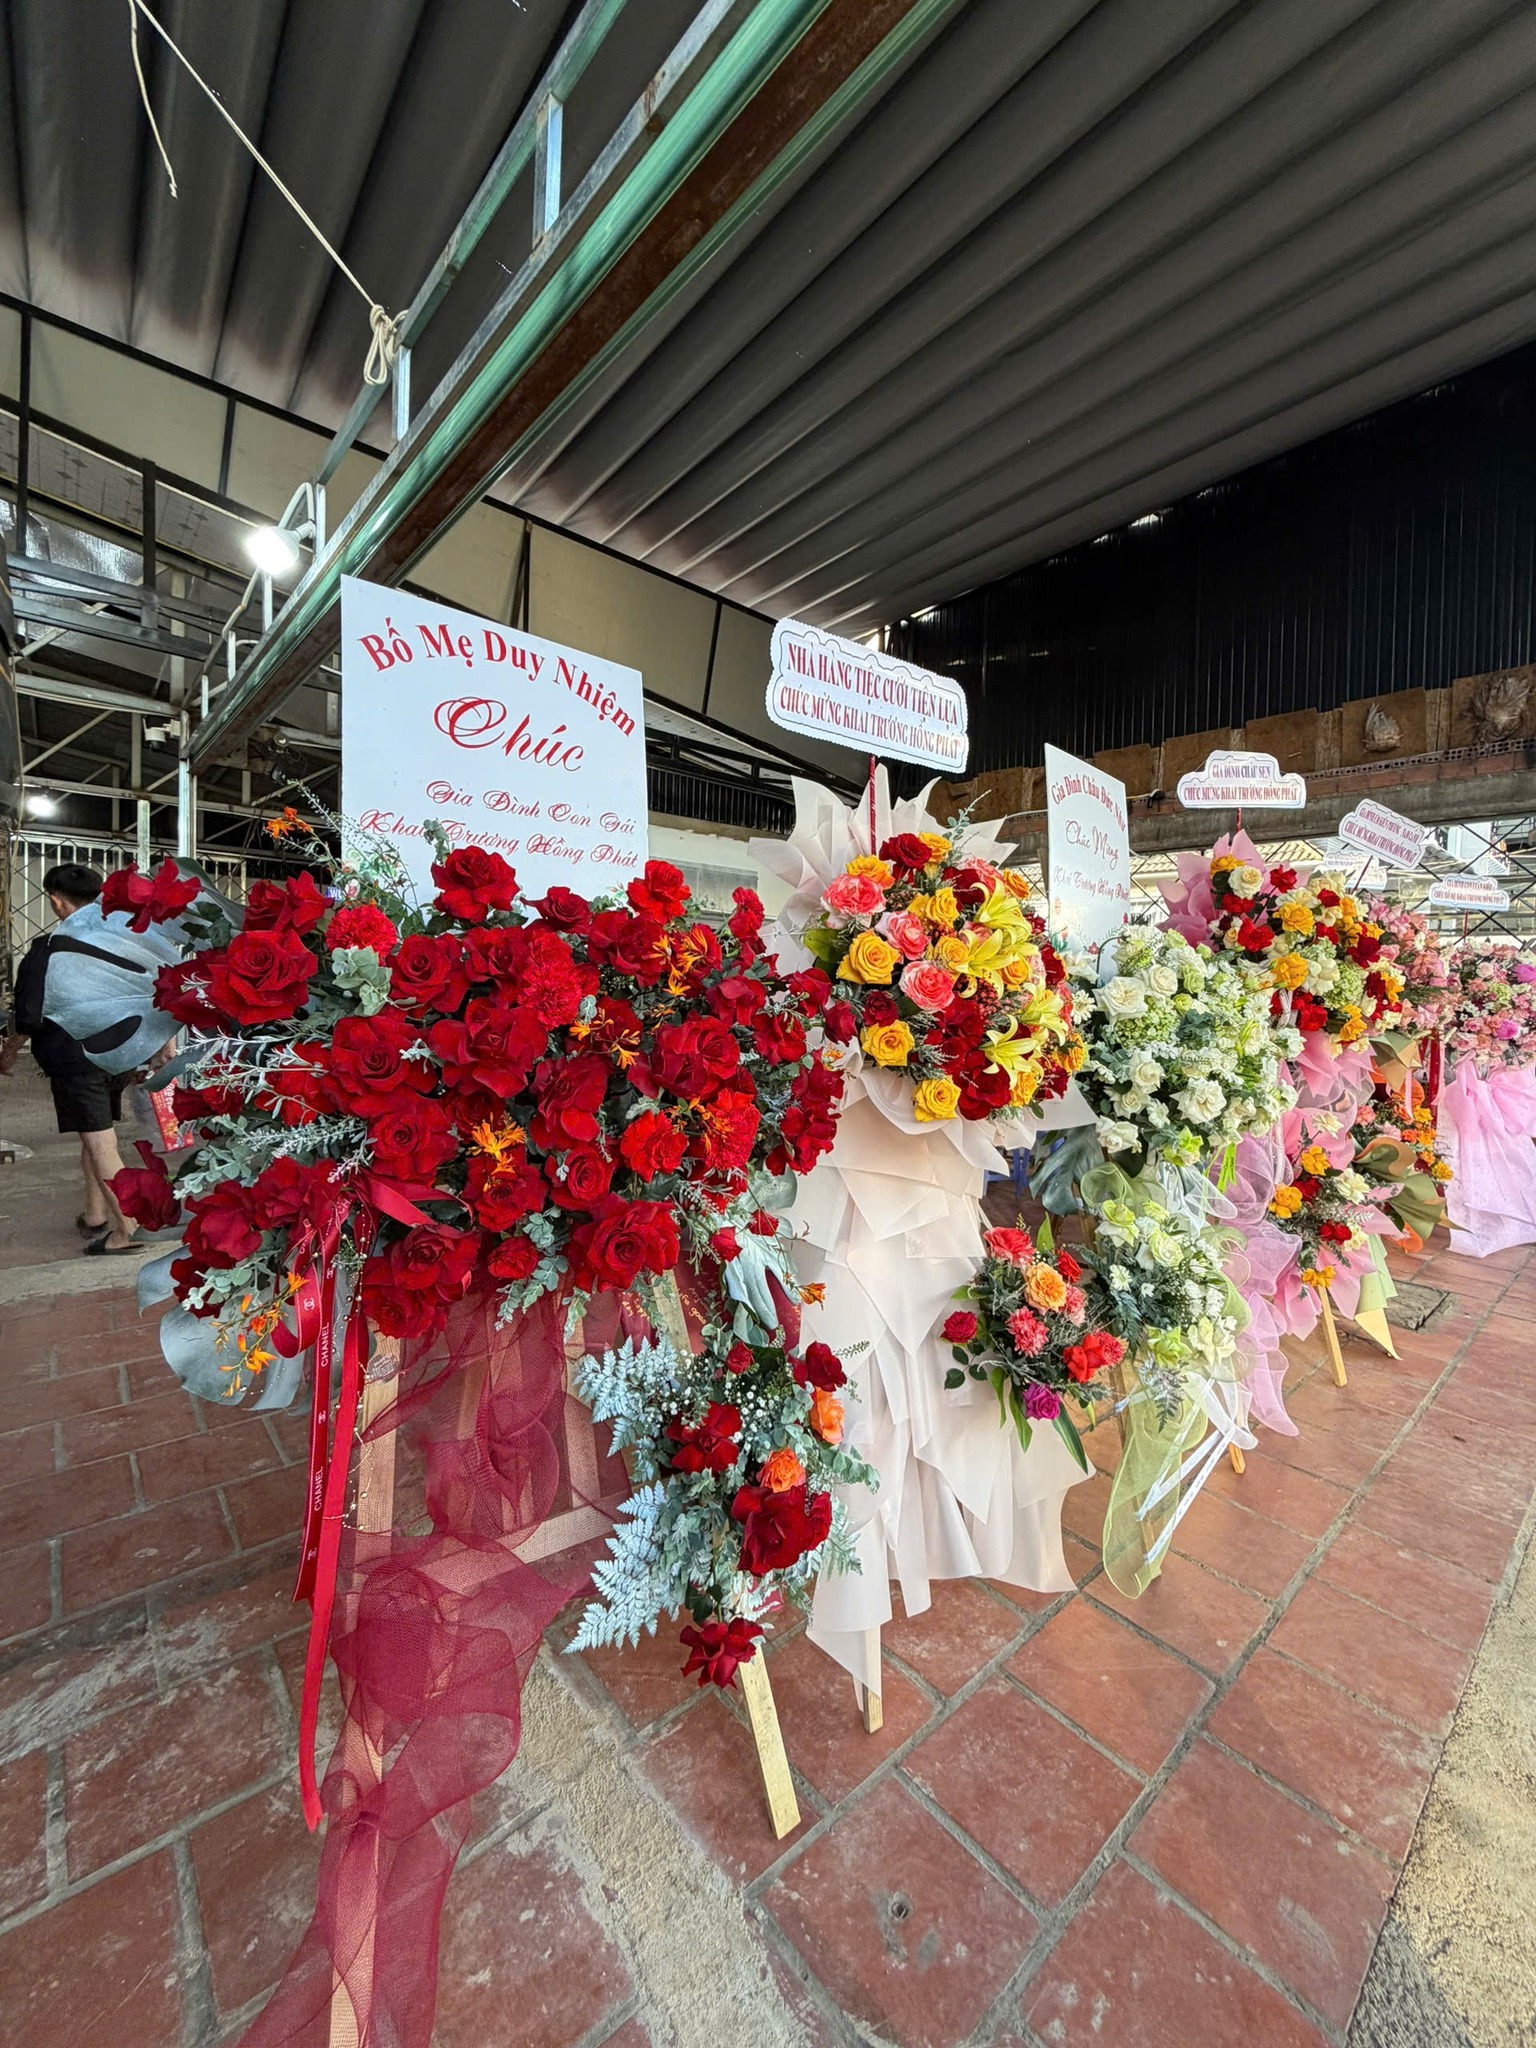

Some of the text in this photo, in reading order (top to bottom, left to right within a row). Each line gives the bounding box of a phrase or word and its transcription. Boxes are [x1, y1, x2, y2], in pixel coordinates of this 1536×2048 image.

[357, 617, 635, 737] Bố Mẹ Duy Nhiệm
[787, 642, 815, 679] NHÀ
[818, 648, 852, 690] HÀNG
[854, 664, 880, 706] TIỆC
[882, 675, 909, 709] CƯỚI
[434, 696, 584, 772] Chúc
[780, 683, 809, 716] CHÚC
[811, 691, 842, 725] MỪNG
[843, 705, 868, 734] KHAI
[909, 718, 935, 754] HỒNG
[935, 731, 959, 760] PHÁT
[426, 781, 637, 835] Gia Đình Con Gái
[1051, 778, 1065, 805] Gia
[1063, 773, 1082, 799] Đình
[360, 809, 425, 837] Khai
[526, 833, 584, 865] Hồng
[590, 844, 638, 868] Phát
[321, 1320, 330, 1368] CHANEL
[314, 1465, 324, 1512] CHANEL
